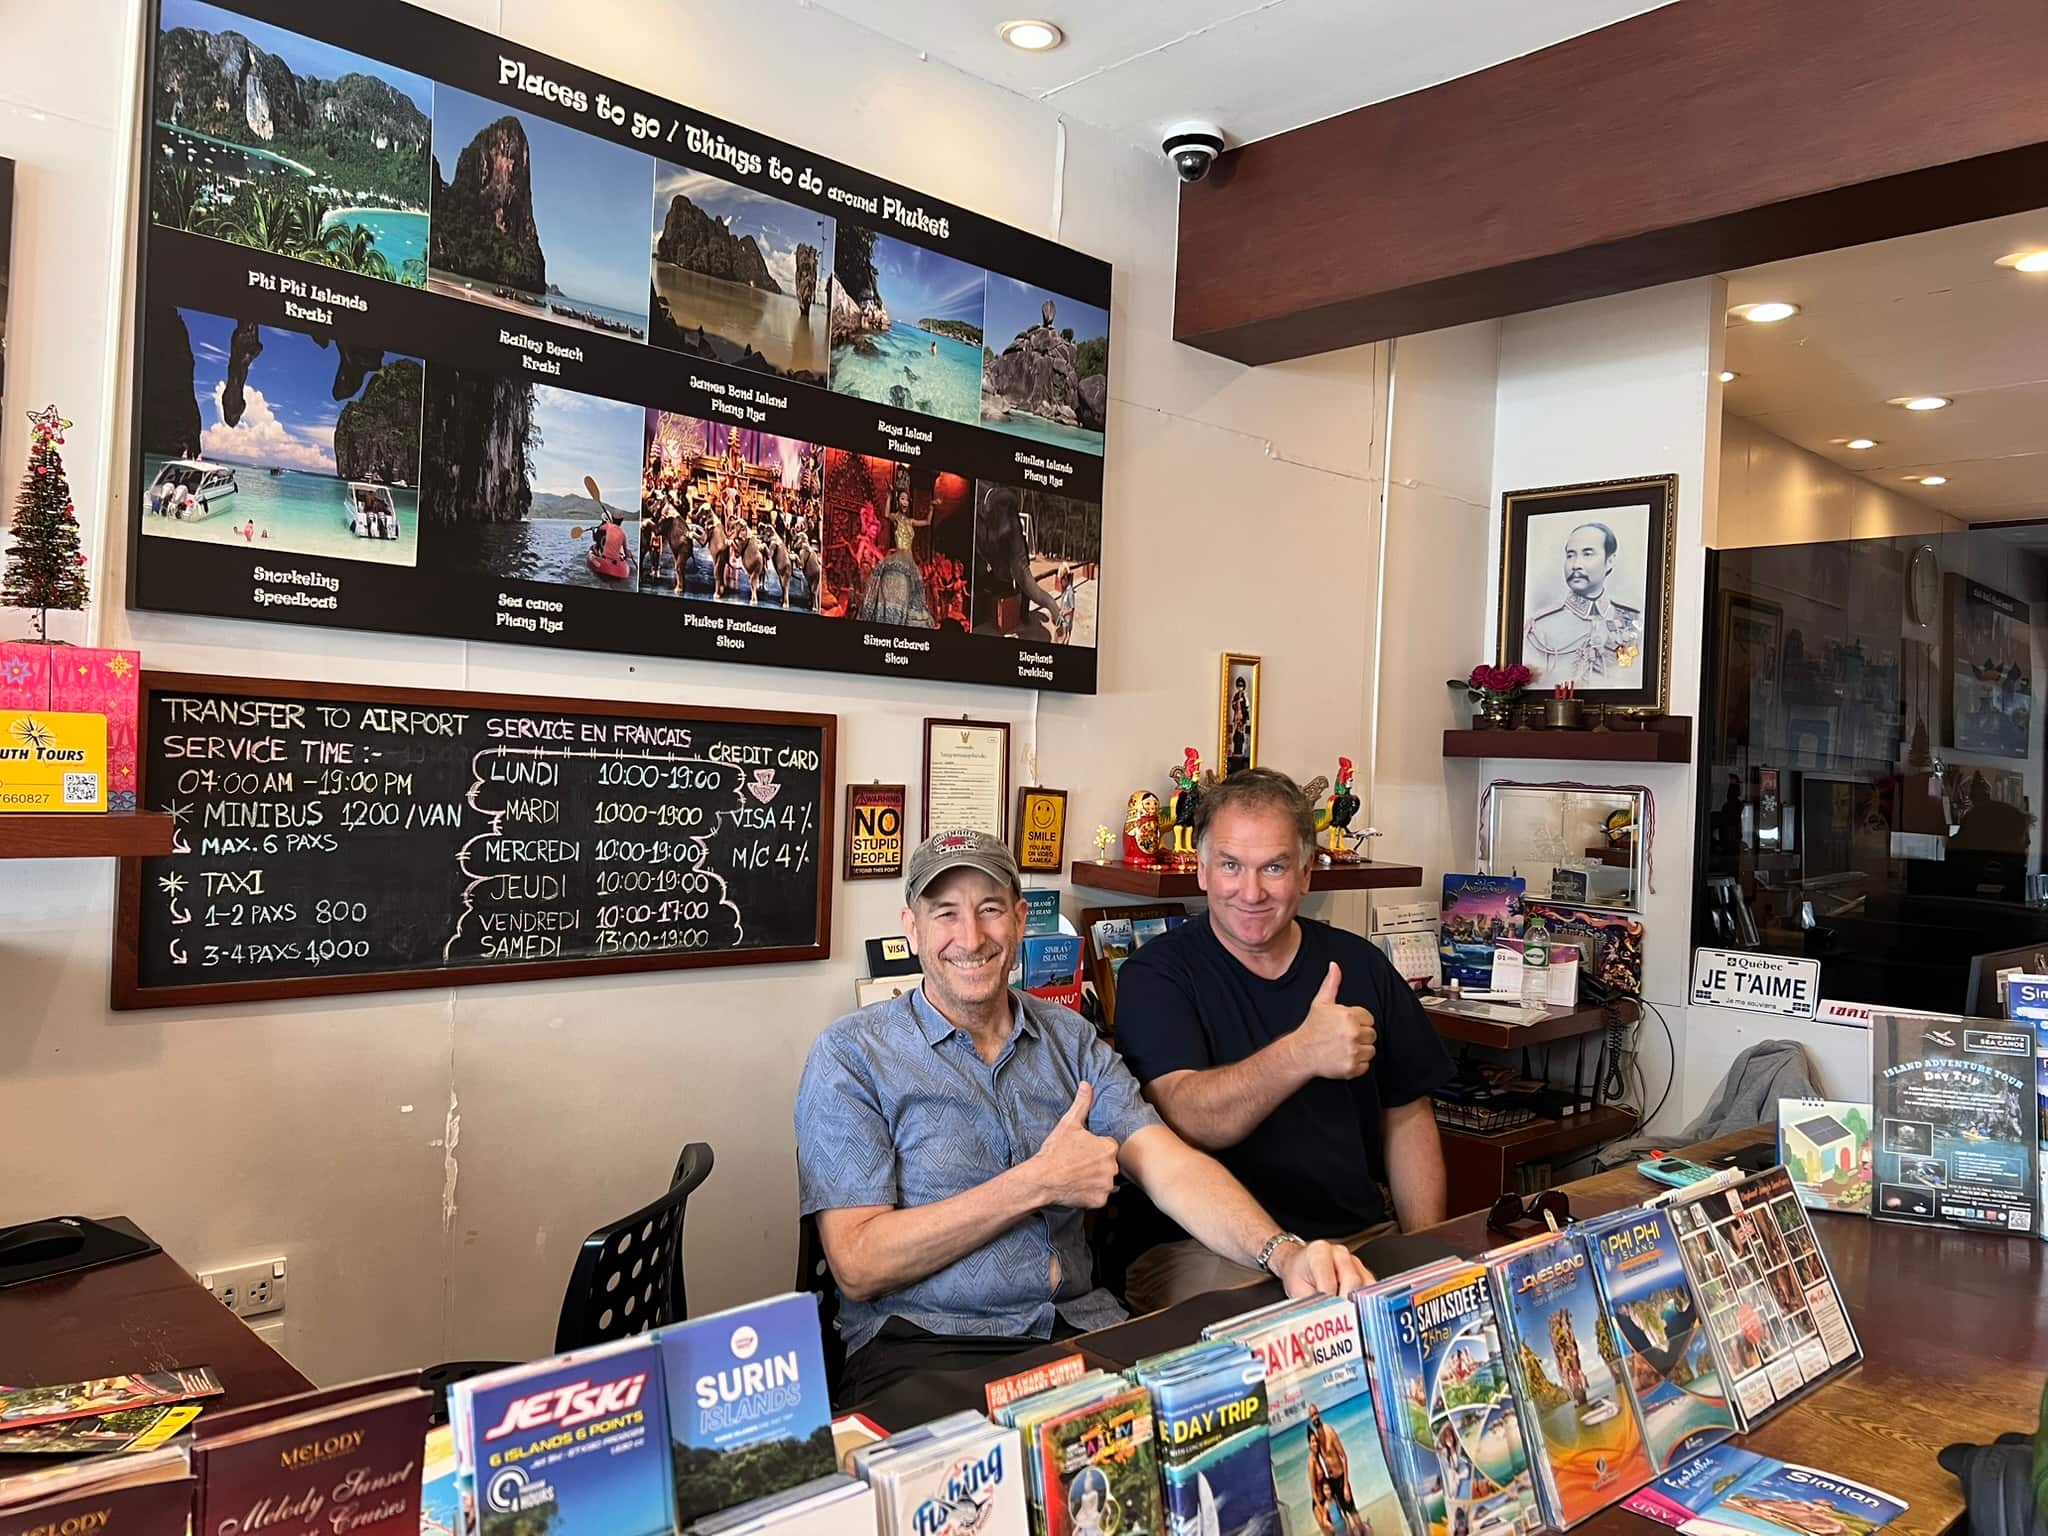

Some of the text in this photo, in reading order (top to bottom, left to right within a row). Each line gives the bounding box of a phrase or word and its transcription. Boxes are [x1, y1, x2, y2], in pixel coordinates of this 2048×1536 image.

[498, 56, 588, 113] Places
[595, 92, 625, 127] to
[631, 111, 661, 141] go
[685, 123, 762, 175] Things
[768, 154, 794, 185] to
[798, 167, 823, 196] do
[827, 185, 878, 215] around
[882, 195, 950, 239] Phuket
[248, 270, 368, 313] Phi Phi Islands
[284, 301, 334, 325] Krabi
[499, 329, 584, 362] Railey Beach
[522, 355, 561, 376] Krabi
[689, 375, 788, 409] James Bond Island
[711, 397, 767, 423] Phang Nga
[877, 420, 933, 443] Raya Island
[887, 438, 921, 456] Phuket
[1014, 451, 1073, 474] Similan Islands
[1024, 469, 1064, 487] Phang Nga
[253, 566, 340, 591] Snorkeling
[253, 588, 338, 610] Speedboat
[498, 593, 563, 613] Sea canoe
[496, 612, 564, 633] Phang Nga
[683, 613, 777, 635] Phuket Fantasea
[716, 634, 745, 650] Show
[863, 634, 930, 652] Simon Cabaret
[884, 651, 909, 666] Show
[1019, 651, 1053, 666] Elephant
[1018, 666, 1054, 681] Trekking
[161, 698, 469, 737] TRANSFER TO AIRPORT
[486, 717, 692, 749] SERVICE EN FRANCAIS
[164, 736, 288, 763] SERVICE
[708, 741, 819, 771] CREDIT CARD
[177, 769, 259, 795] 07:00
[262, 772, 294, 793] AM
[384, 772, 413, 796] PM
[490, 761, 559, 787] LUNDI
[203, 800, 324, 829] MINIBUS
[505, 797, 560, 824] MARDI
[731, 806, 776, 831] VISA
[854, 808, 900, 837] NO
[201, 834, 339, 857] MAX. 6 PAXS
[853, 838, 899, 851] STUPID
[1028, 831, 1056, 842] SMILE
[485, 839, 581, 863] MERCREDI
[733, 840, 771, 870] M/C
[852, 851, 899, 864] PEOPLE
[199, 870, 265, 897] TAXI
[490, 873, 567, 900] JEUDI
[205, 899, 367, 927] 1-2 PAXS 800
[479, 908, 581, 932] VENDREDI
[202, 943, 246, 966] 3-4
[250, 942, 301, 963] PAXS
[480, 935, 561, 959] SAMEDI
[887, 943, 906, 954] VISA
[1738, 958, 1784, 972] Québec
[1702, 969, 1807, 1001] JE T'AIME
[1882, 1058, 2025, 1090] ISLAND ADVENTURE TOUR
[1923, 1071, 1981, 1086] Day Trip
[1608, 1220, 1661, 1257] PHI PHI
[1620, 1241, 1655, 1261] ISLAND
[1304, 1314, 1353, 1344] CORAL
[1400, 1310, 1416, 1344] 3
[1313, 1338, 1353, 1365] ISLAND
[696, 1351, 800, 1409] SURIN
[699, 1383, 802, 1435] ISLANDS
[1174, 1409, 1214, 1444] DAY
[1216, 1396, 1260, 1428] TRIP
[505, 1435, 573, 1465] ISLANDS
[575, 1428, 588, 1443] 6
[589, 1410, 645, 1438] POINTS
[217, 1460, 414, 1535] Melody Sunset
[1785, 1469, 1881, 1509] Similan
